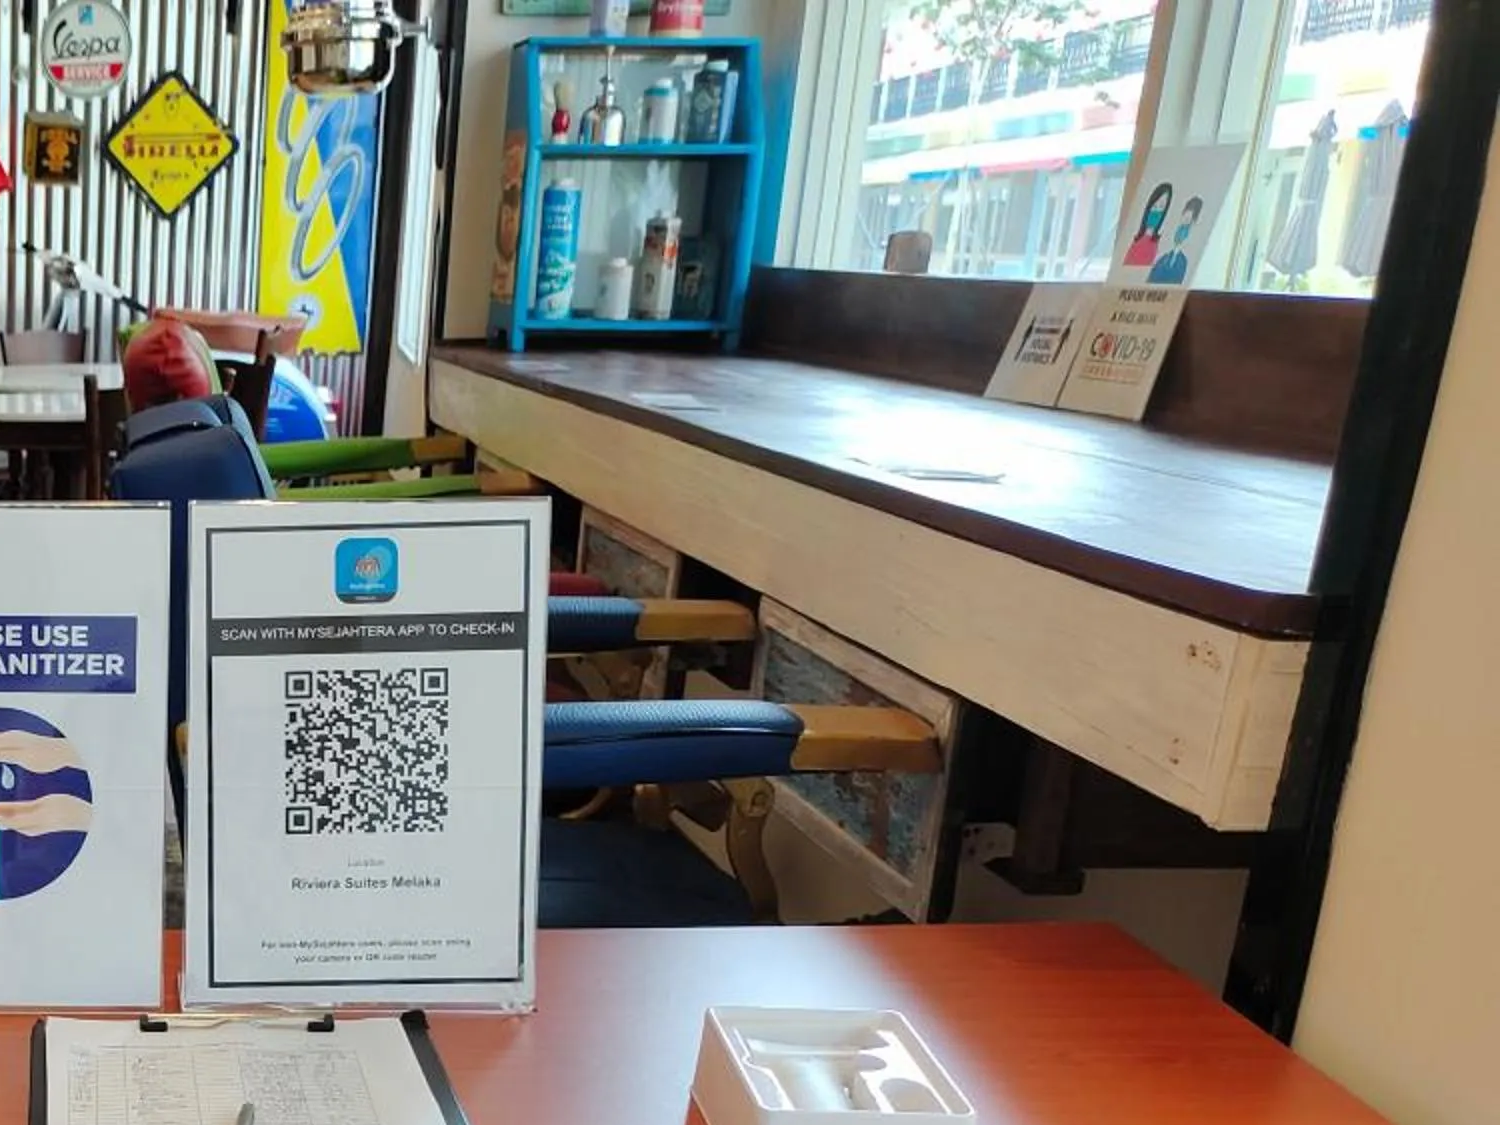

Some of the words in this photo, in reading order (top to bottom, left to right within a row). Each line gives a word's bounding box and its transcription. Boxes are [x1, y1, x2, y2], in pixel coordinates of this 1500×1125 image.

[52, 20, 121, 60] Vespa
[31, 624, 90, 647] USE
[220, 628, 257, 641] SCAN
[261, 627, 294, 640] WITH
[297, 625, 396, 640] MYSEJAHTERA
[398, 624, 425, 637] APP
[429, 623, 447, 636] TO
[450, 621, 515, 635] CHECK-IN
[291, 877, 341, 890] Riviera
[344, 876, 388, 889] Suites
[391, 876, 441, 888] Melaka
